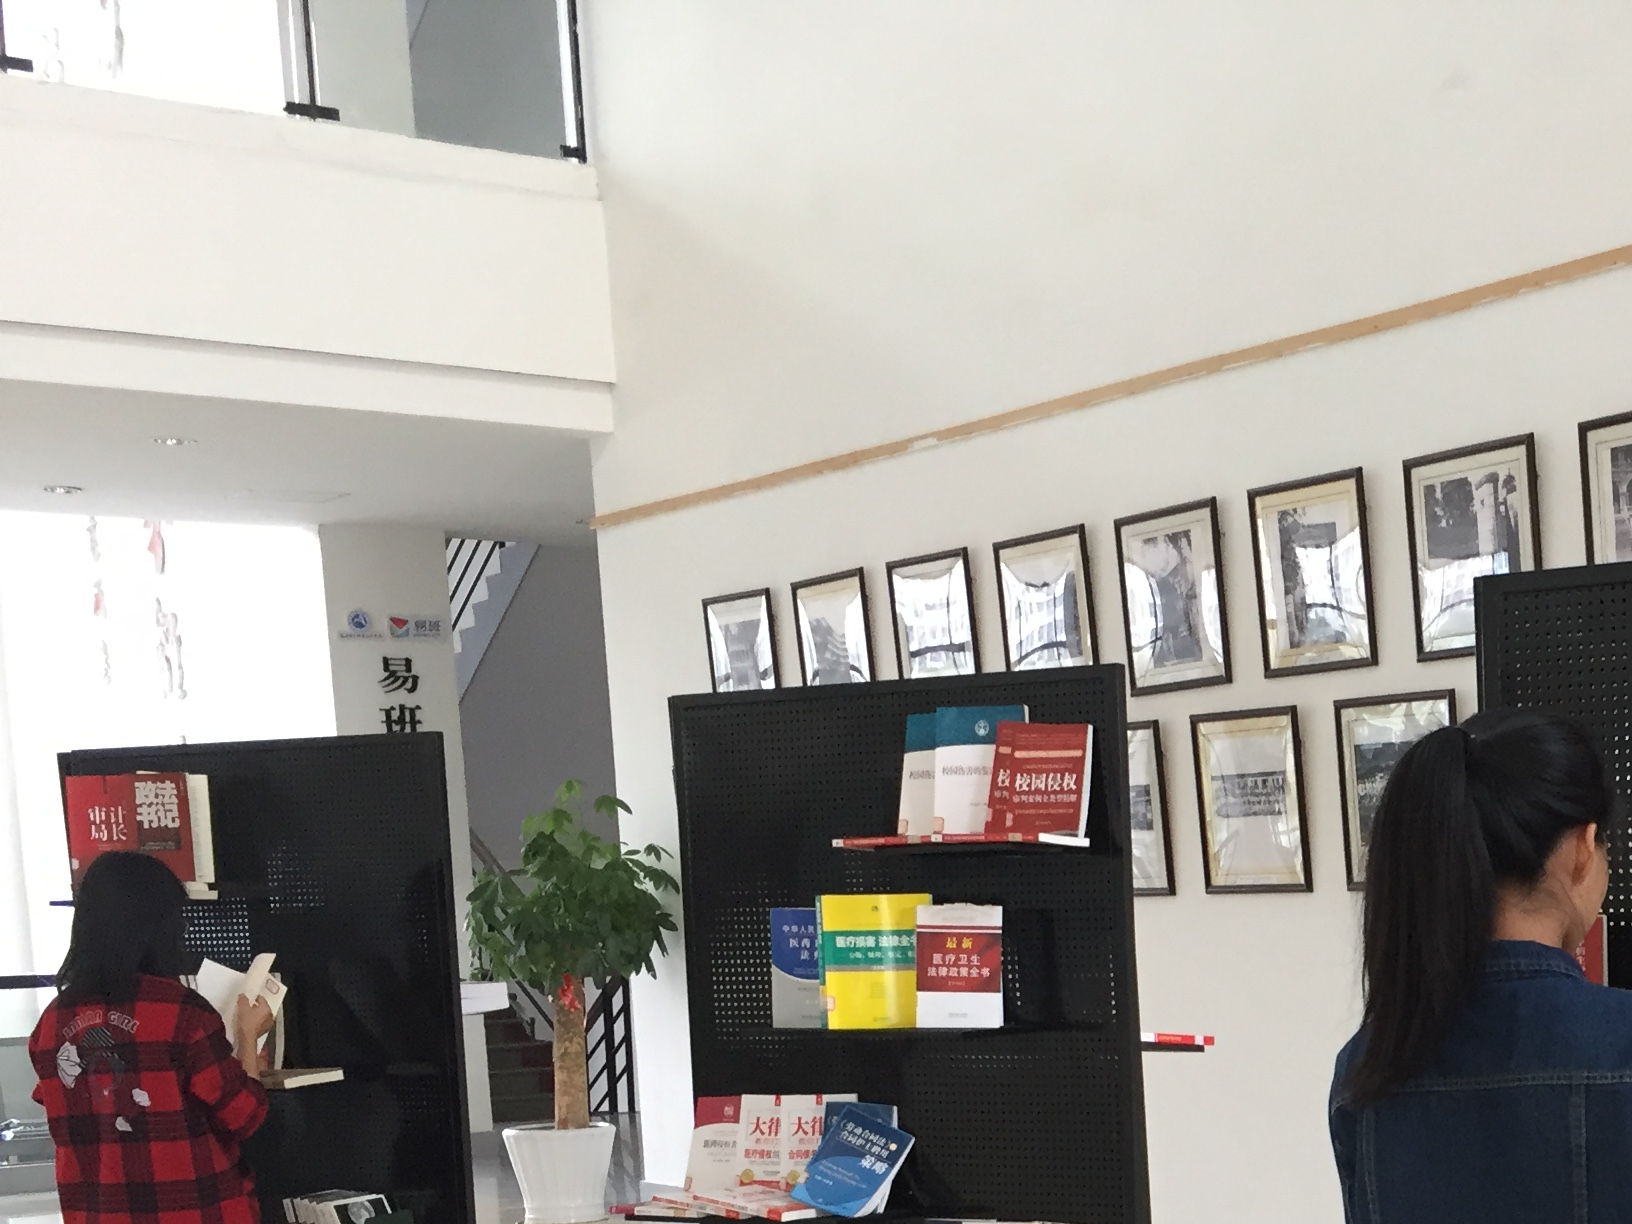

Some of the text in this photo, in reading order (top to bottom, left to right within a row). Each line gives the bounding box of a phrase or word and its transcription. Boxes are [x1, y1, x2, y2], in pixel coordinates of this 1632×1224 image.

[378, 656, 423, 733] 易班
[1015, 771, 1077, 791] 校园侵权
[135, 780, 178, 804] 政法
[88, 806, 126, 824] 审计
[136, 803, 181, 829] 书记
[91, 824, 128, 841] 局长
[946, 937, 974, 949] 最新
[932, 953, 981, 965] 医疗卫生
[927, 967, 991, 978] 法律政策全书
